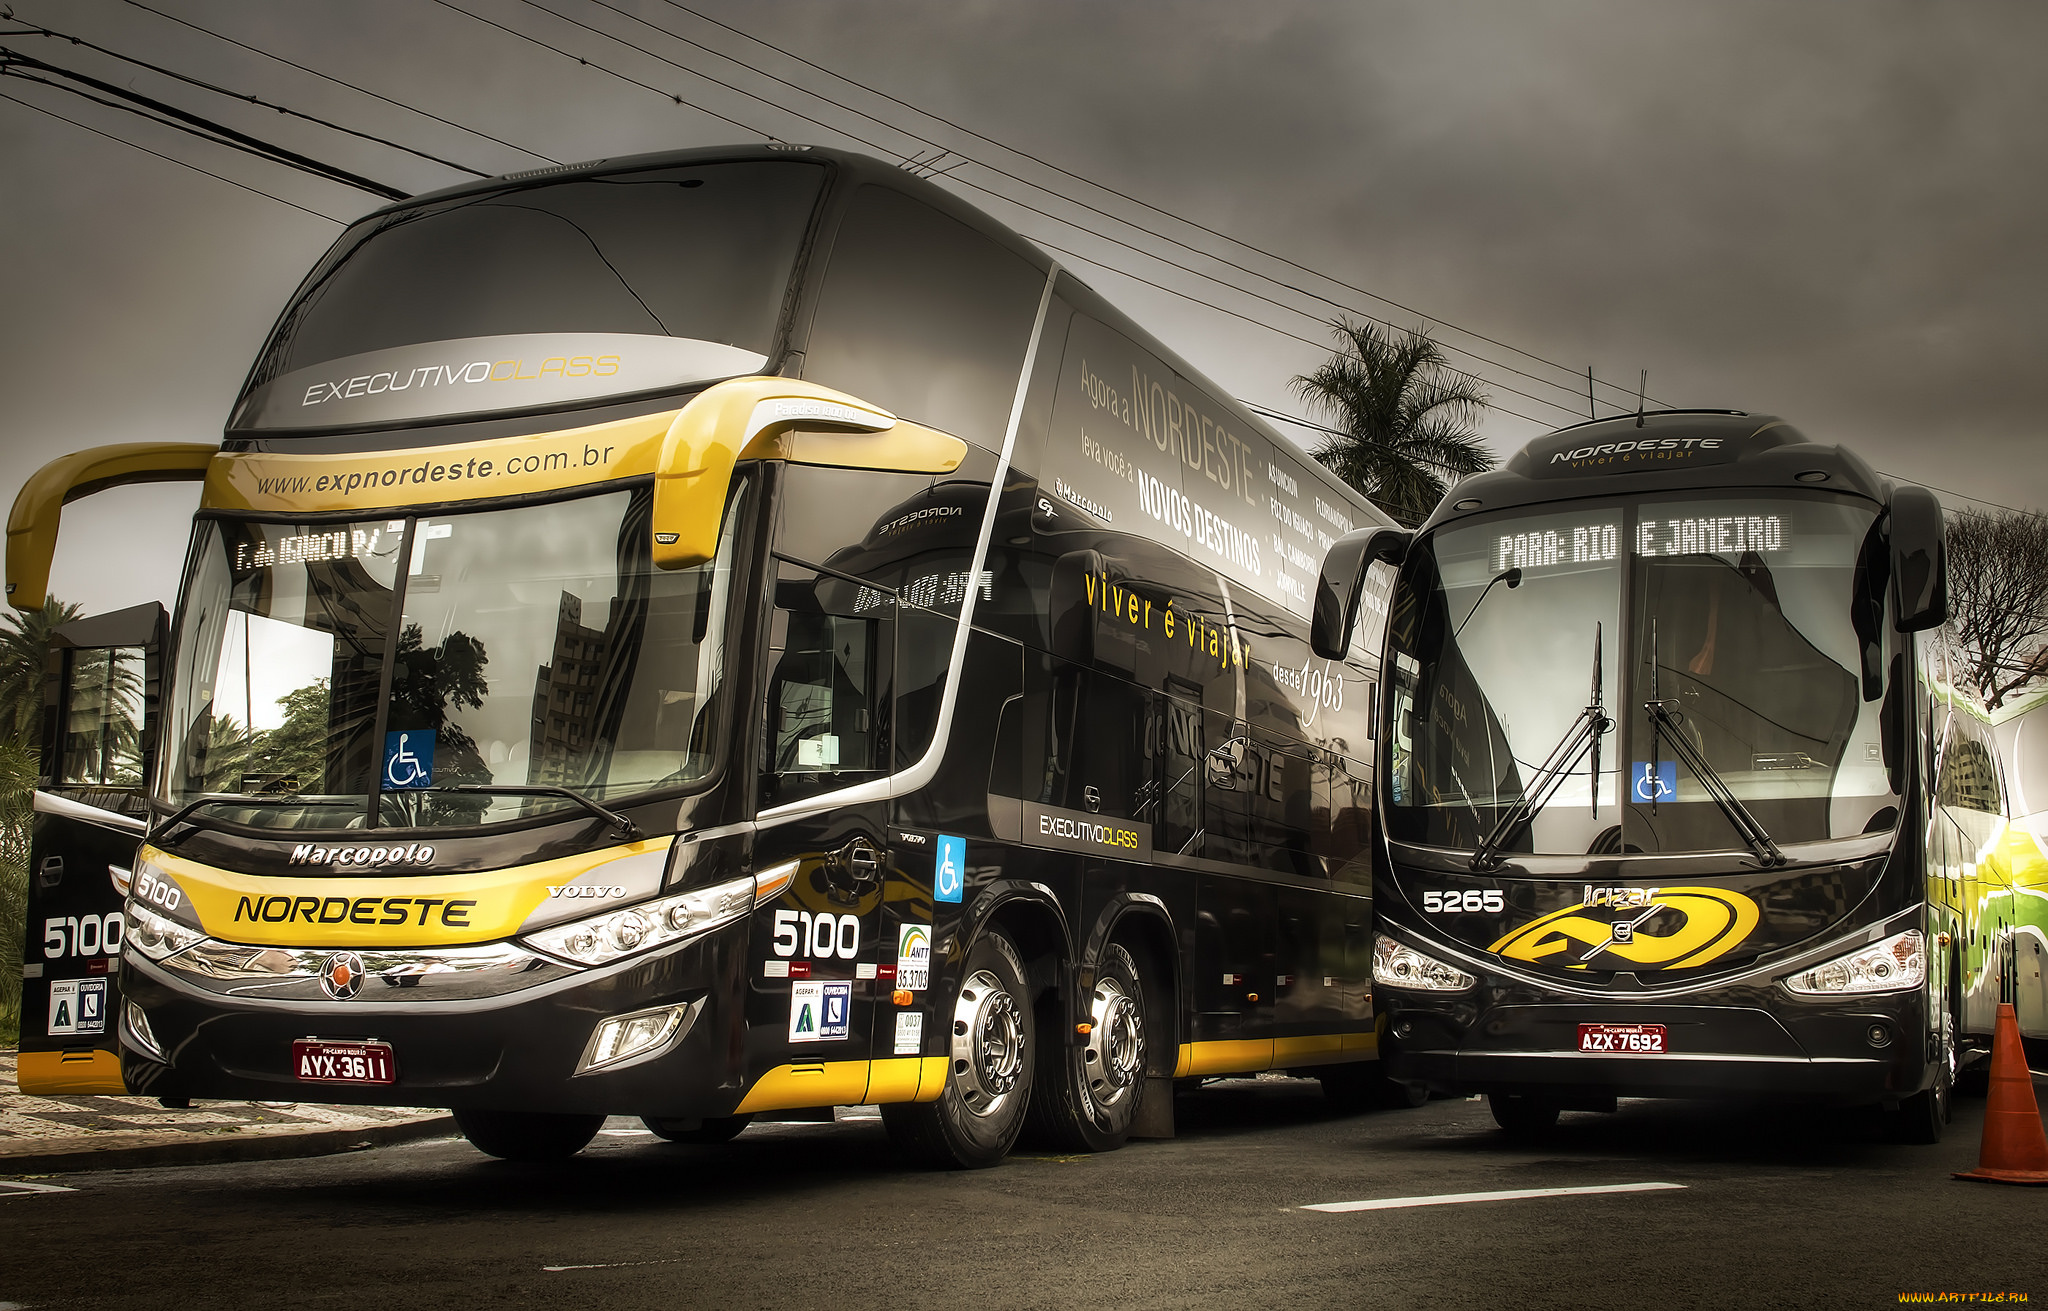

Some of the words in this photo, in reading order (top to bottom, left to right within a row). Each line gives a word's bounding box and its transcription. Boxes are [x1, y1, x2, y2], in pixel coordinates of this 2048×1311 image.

[774, 402, 820, 417] Paradiso
[1081, 359, 1119, 418] Agora
[1122, 397, 1131, 427] a
[1132, 364, 1256, 507] NORDESTE
[1550, 438, 1724, 464] NORDESTE
[1571, 455, 1614, 469] viver
[1622, 452, 1631, 462] é
[1639, 450, 1693, 460] viajar
[257, 443, 614, 496] www.expnordeste.com.br
[1063, 483, 1113, 522] Marcopolo
[1080, 427, 1101, 464] leva
[1102, 447, 1125, 478] você
[1127, 462, 1134, 484] a
[1137, 468, 1193, 538] NOVOS
[1193, 502, 1261, 577] DESTINOS
[1499, 530, 1565, 570] PARA:
[1573, 524, 1617, 563] RIO
[1636, 521, 1656, 557] E
[1666, 515, 1780, 555] JANEIRO
[1085, 571, 1151, 629] viver
[1164, 599, 1175, 639] é
[1187, 615, 1250, 670] viajar
[1273, 660, 1300, 691] desde
[1300, 657, 1343, 728] 1963
[289, 843, 435, 868] Marcopolo
[137, 872, 181, 911] 5100
[545, 885, 627, 899] VOLVO
[1423, 889, 1504, 914] 5265
[1583, 884, 1660, 908] Irizar
[233, 896, 478, 928] NORDESTE
[44, 911, 124, 959] 5100
[772, 908, 860, 960] 5100
[911, 946, 930, 959] ANTT
[897, 969, 928, 989] 35.3703
